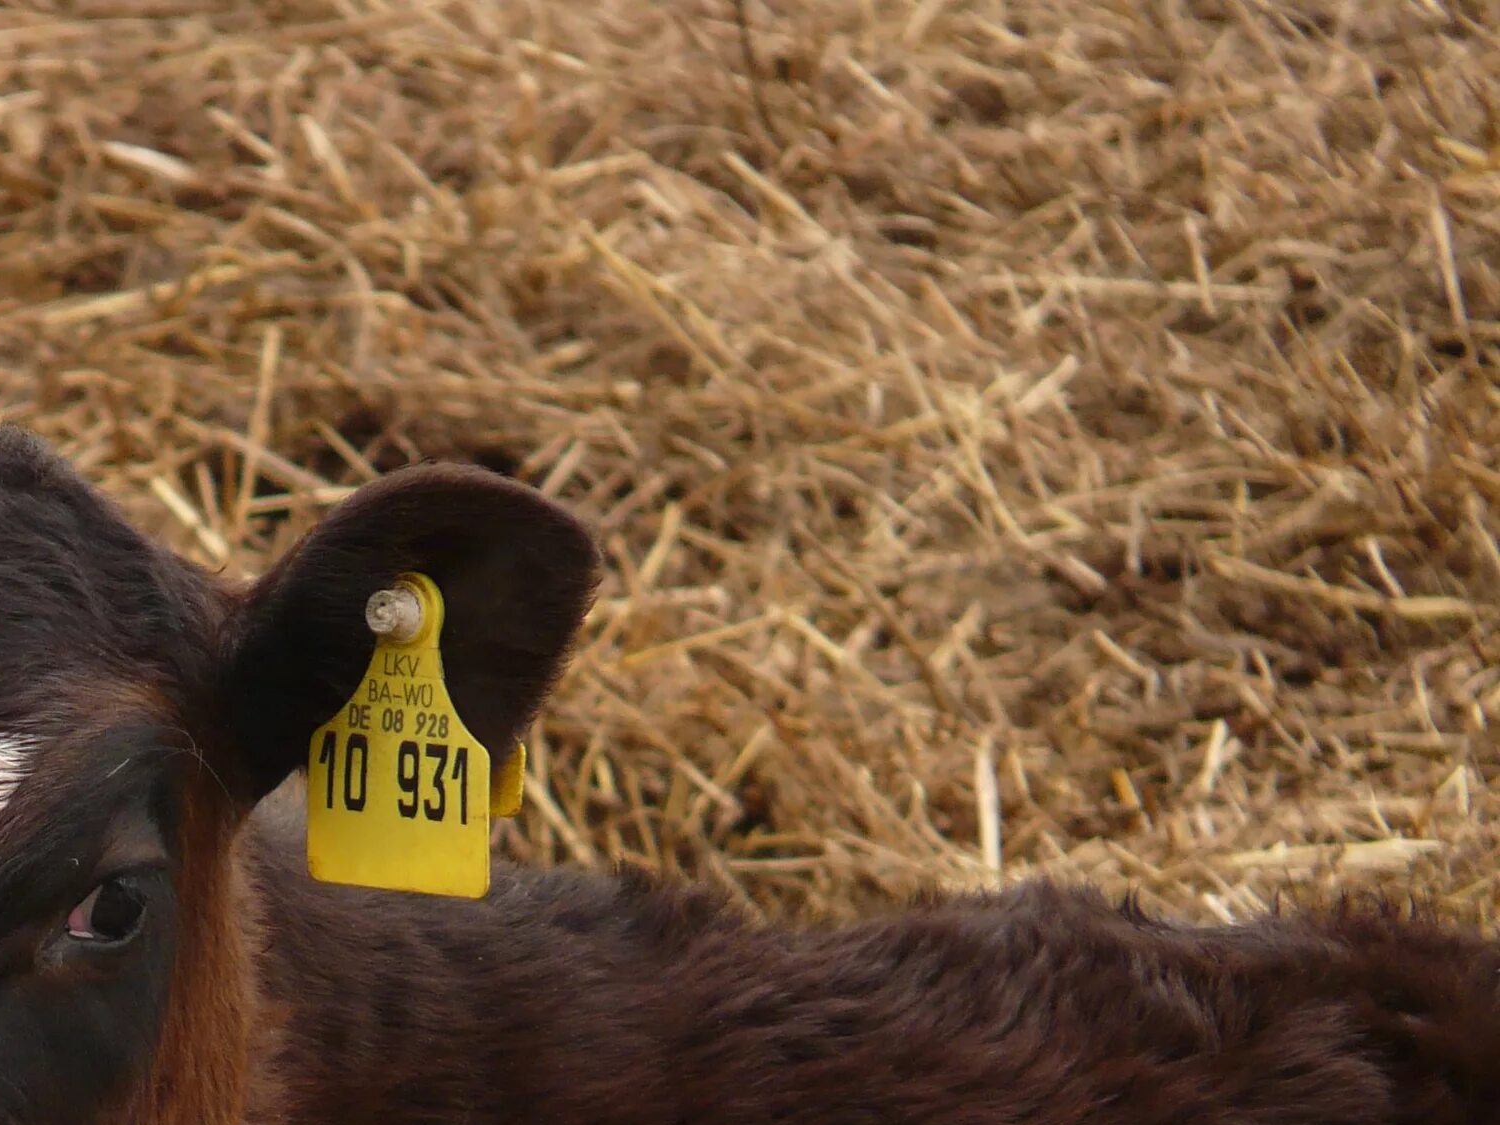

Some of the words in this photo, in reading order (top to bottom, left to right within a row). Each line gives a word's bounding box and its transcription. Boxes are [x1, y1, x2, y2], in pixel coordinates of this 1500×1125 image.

[383, 652, 420, 678] LKV
[349, 703, 372, 730] DE
[382, 708, 404, 733] 08
[415, 711, 449, 739] 928
[319, 731, 367, 812] 10
[397, 740, 468, 825] 931
